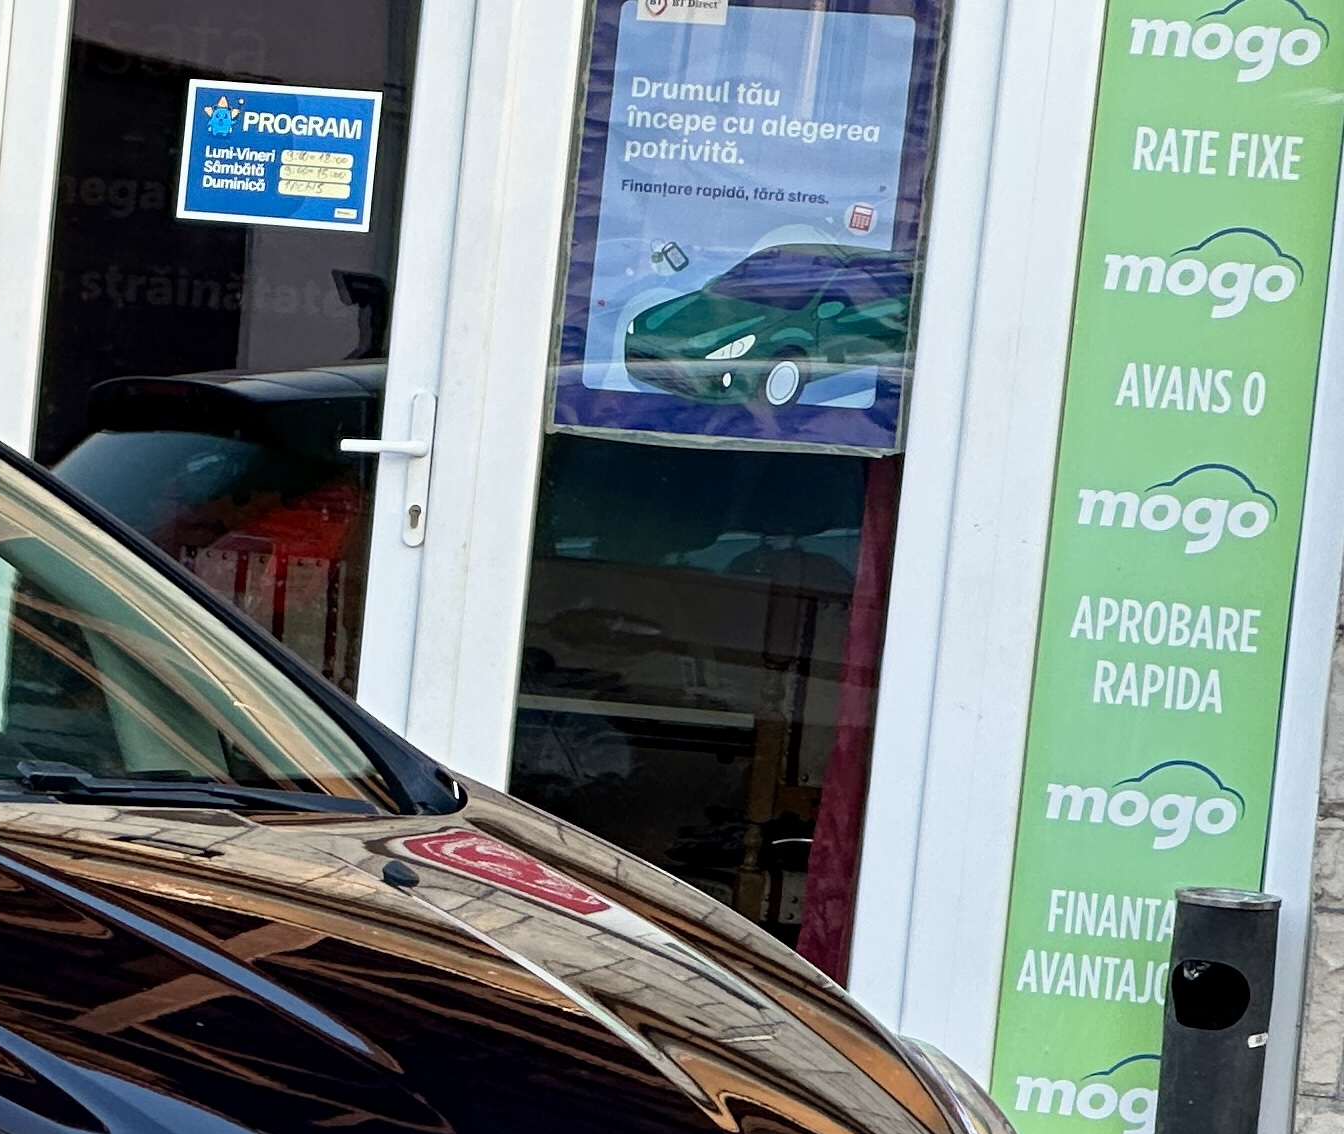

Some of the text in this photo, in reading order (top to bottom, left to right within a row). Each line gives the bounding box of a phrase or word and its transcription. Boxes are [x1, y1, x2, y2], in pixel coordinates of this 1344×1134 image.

[1128, 17, 1321, 83] mogo
[631, 77, 781, 107] Drumul tău
[242, 112, 363, 140] PROGRAM
[626, 105, 880, 143] începe cu alegerea
[205, 145, 276, 162] Luni-Vineri
[624, 138, 745, 165] potrivită.
[1132, 125, 1303, 181] RATE FIXE
[202, 175, 266, 192] Duminică
[788, 190, 830, 204] stres.
[1103, 253, 1296, 319] mogo
[1115, 362, 1232, 416] AVANS
[1077, 488, 1270, 554] mogo
[1070, 595, 1261, 654] APROBARE
[1093, 659, 1223, 713] RAPIDA
[1046, 782, 1238, 849] mogo
